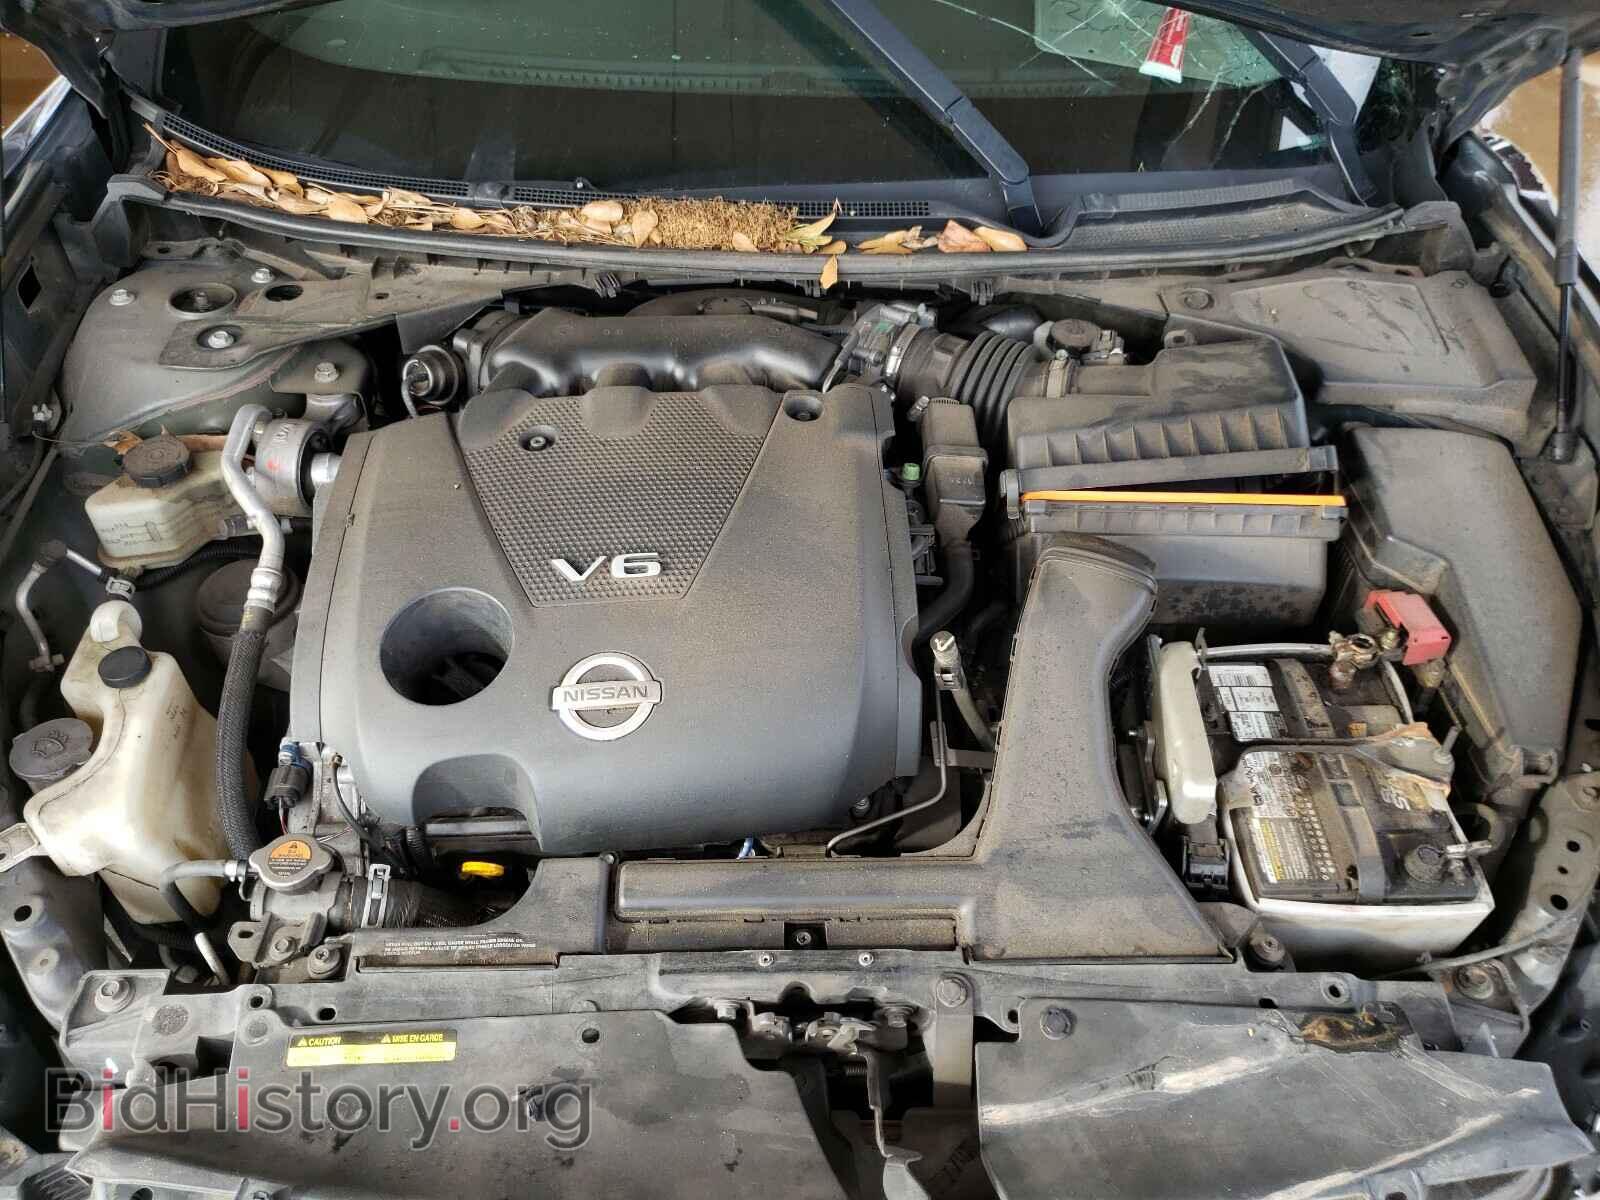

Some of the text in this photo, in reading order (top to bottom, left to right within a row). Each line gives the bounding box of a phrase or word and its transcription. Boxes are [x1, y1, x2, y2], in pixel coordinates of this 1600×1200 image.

[552, 552, 661, 583] V6
[563, 685, 648, 703] NISSAN
[308, 1036, 342, 1047] CAUTION
